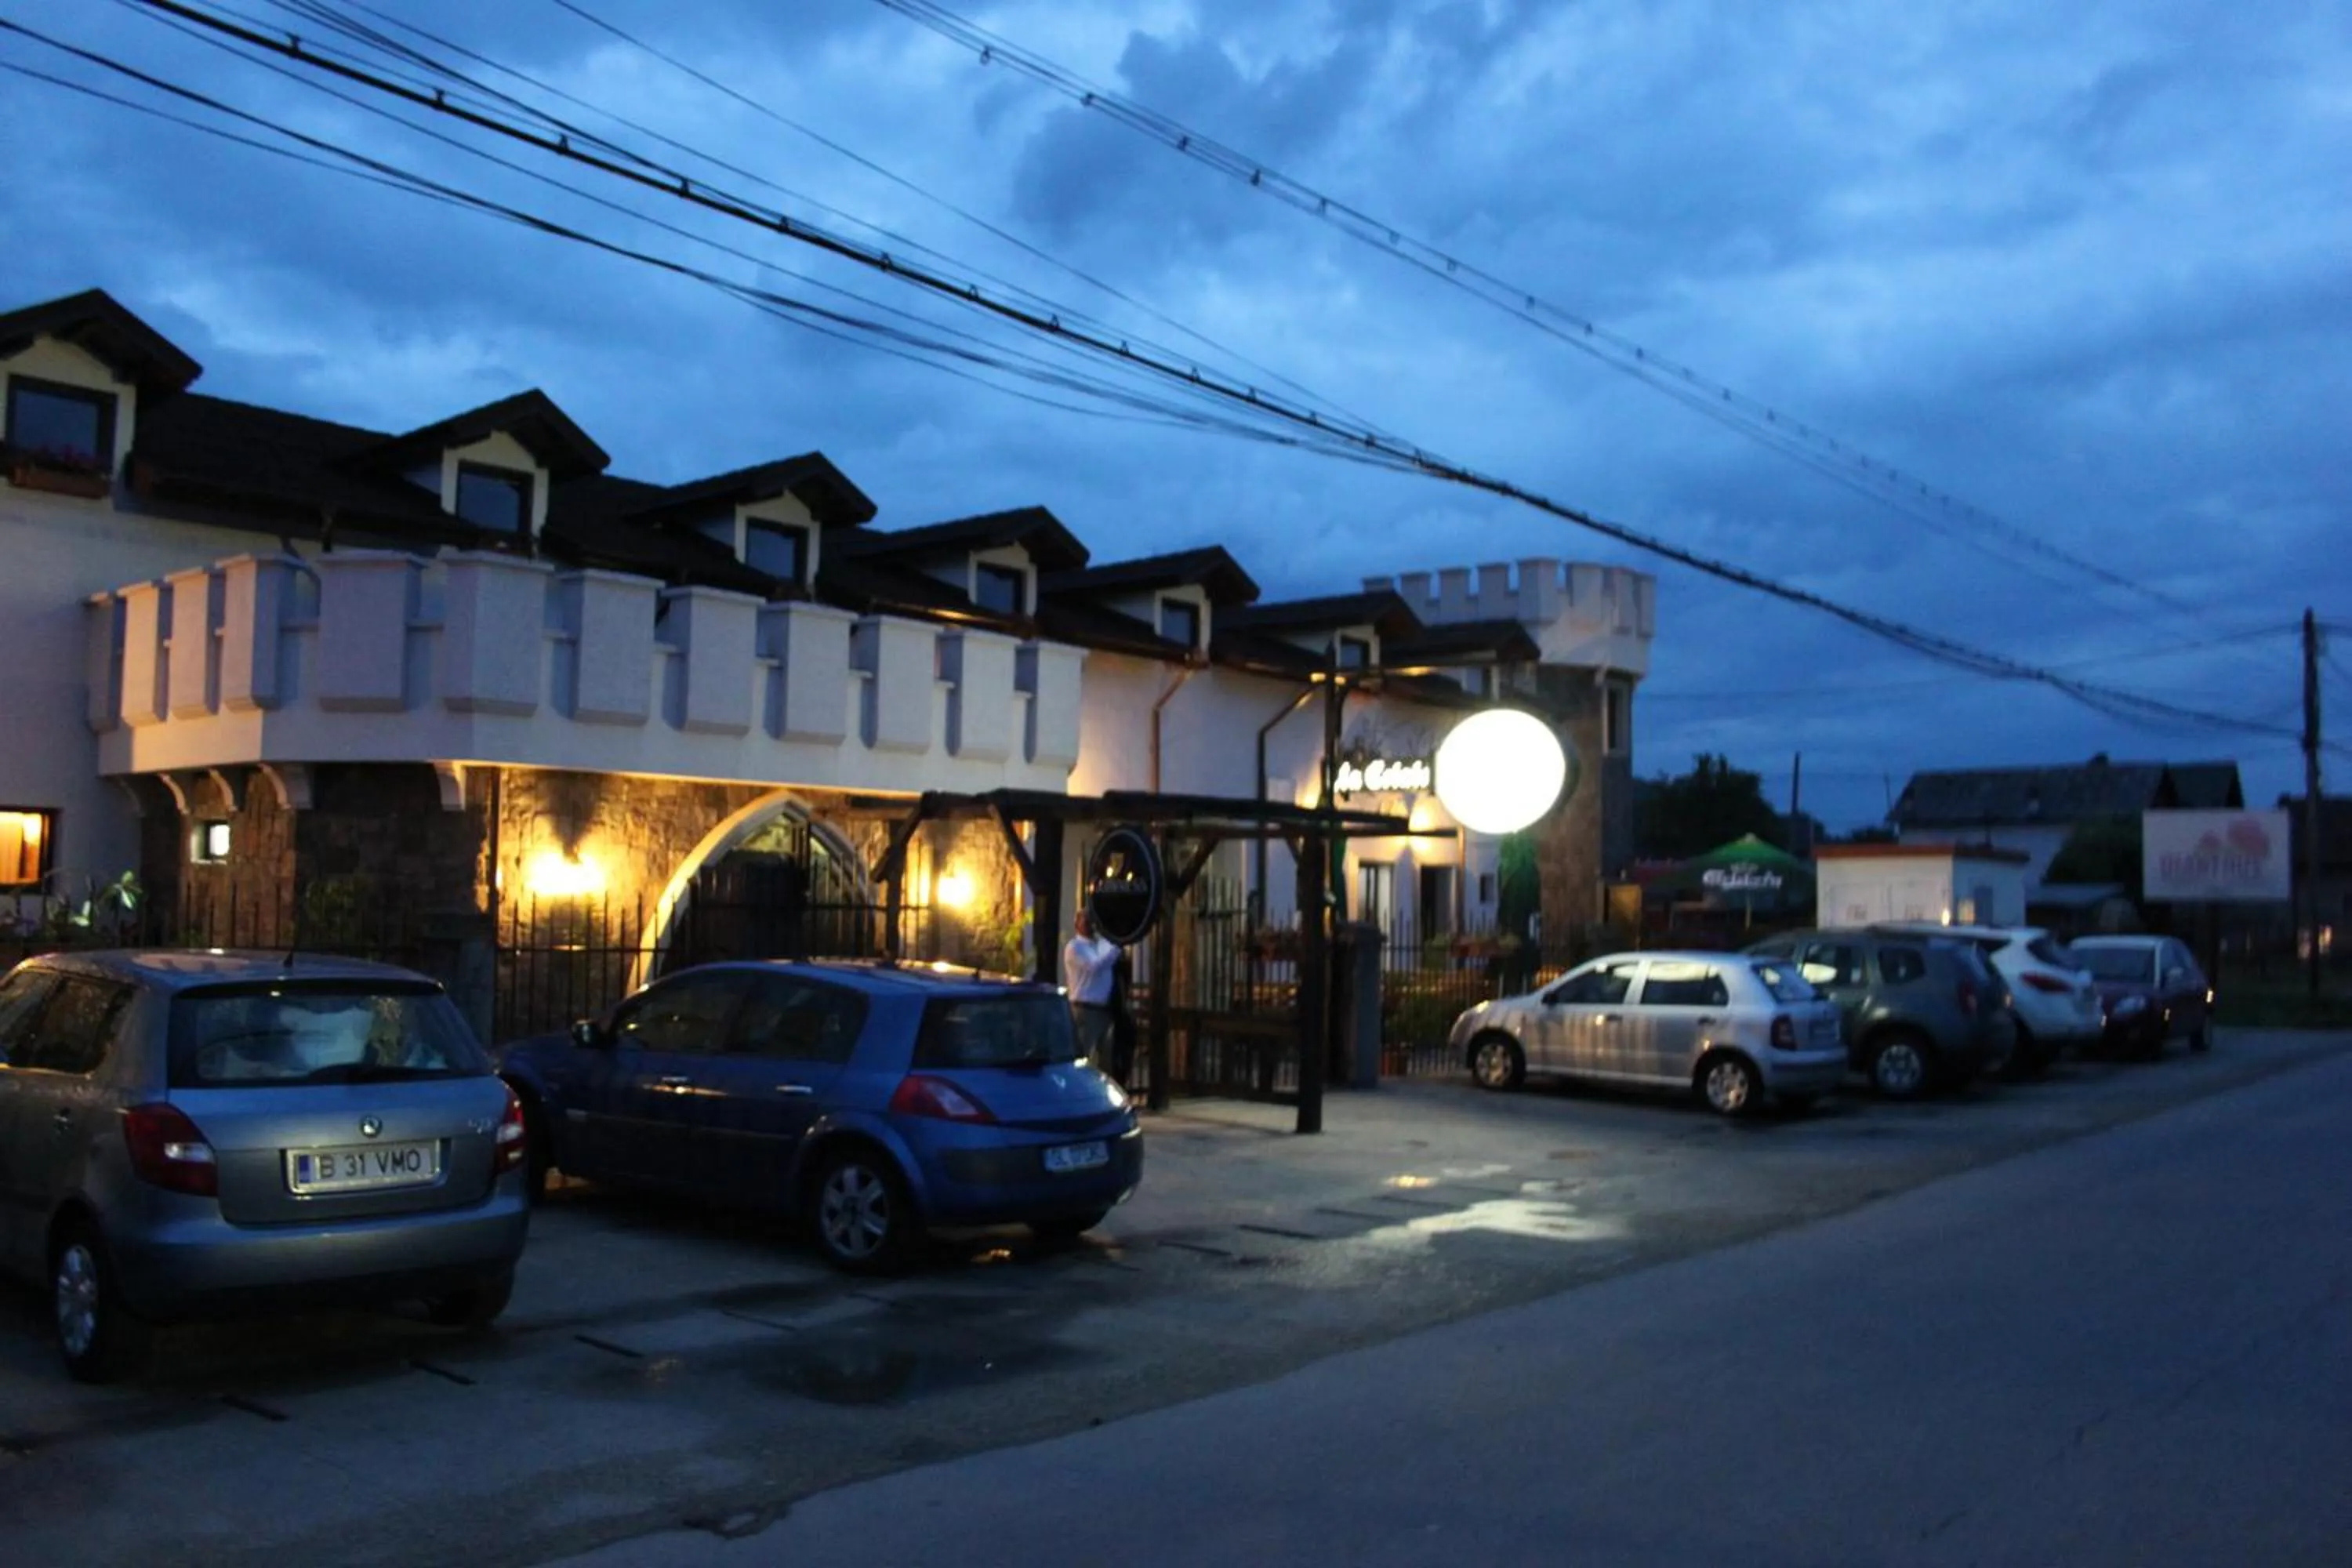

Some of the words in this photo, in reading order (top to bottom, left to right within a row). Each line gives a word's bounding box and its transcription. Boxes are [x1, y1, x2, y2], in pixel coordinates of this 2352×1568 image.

[319, 1155, 335, 1178] B
[345, 1153, 367, 1177] 31
[376, 1148, 422, 1174] VMO
